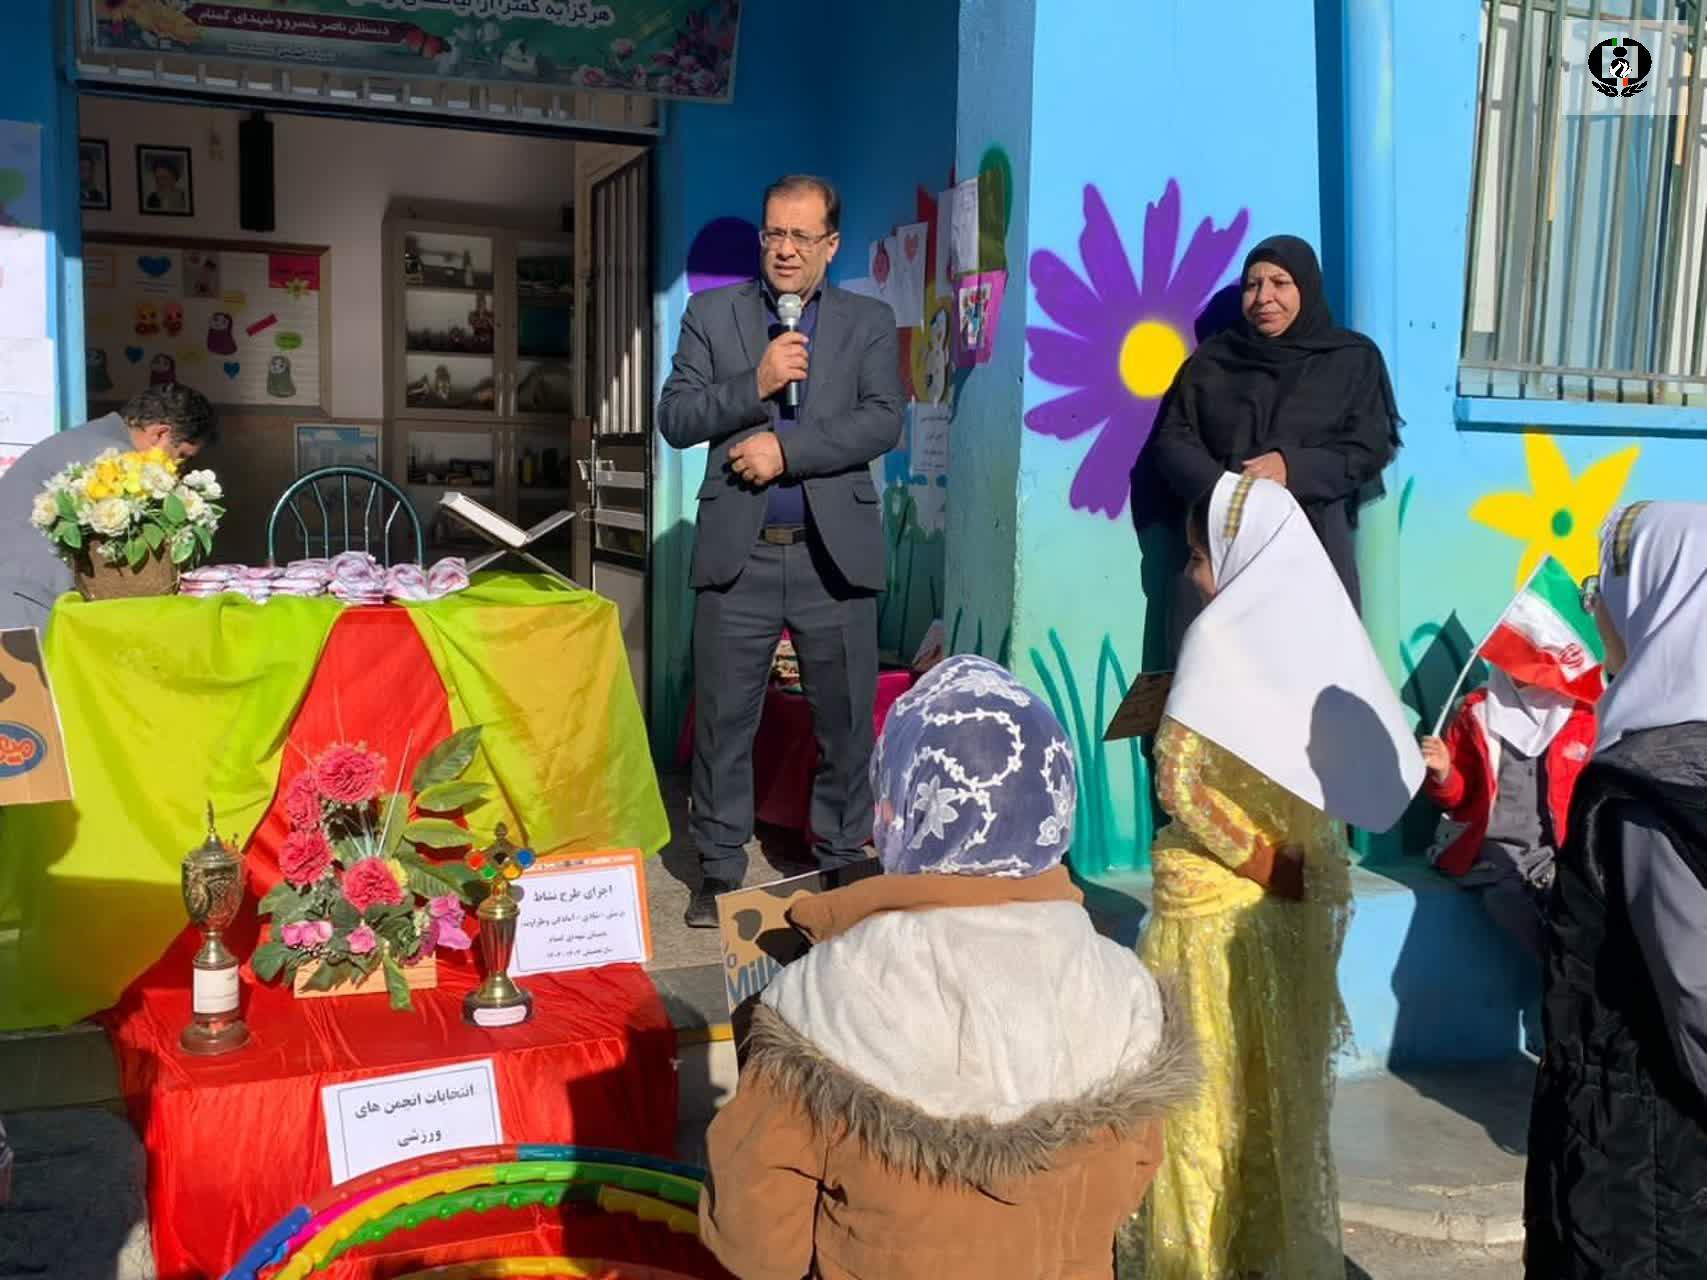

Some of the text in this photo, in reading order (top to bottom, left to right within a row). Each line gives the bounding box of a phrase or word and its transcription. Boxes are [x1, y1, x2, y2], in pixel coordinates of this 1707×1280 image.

[231, 9, 274, 25] شهدای
[319, 20, 347, 32] ناصر
[349, 21, 390, 36] دبستان
[533, 885, 613, 902] اجرای طرح نشاط
[354, 1083, 475, 1119] انتخابات انجمن های
[397, 1129, 443, 1147] ورزشی
